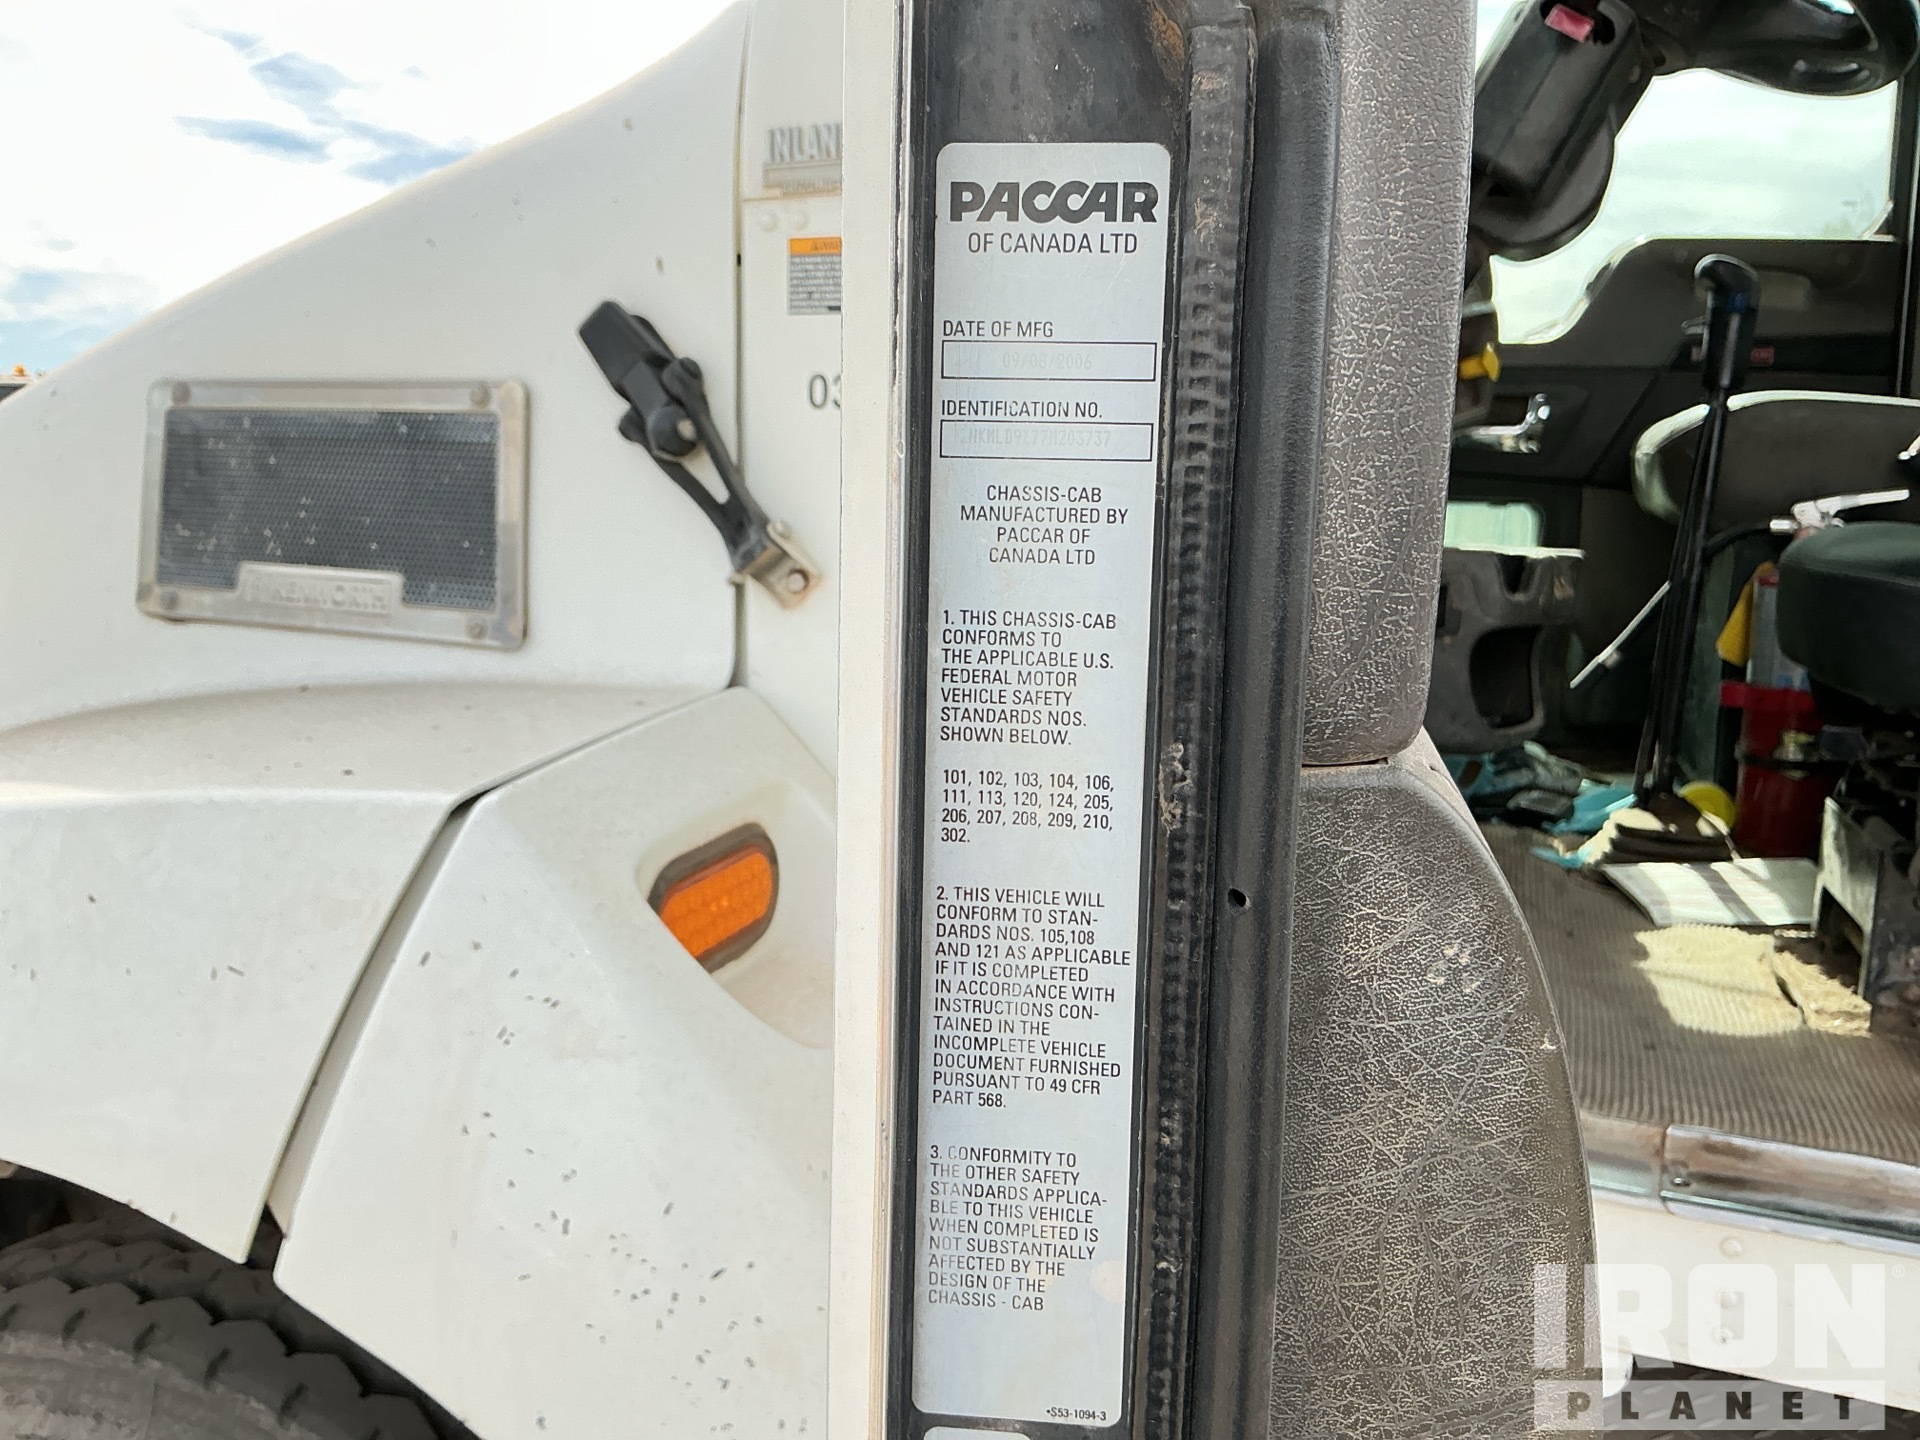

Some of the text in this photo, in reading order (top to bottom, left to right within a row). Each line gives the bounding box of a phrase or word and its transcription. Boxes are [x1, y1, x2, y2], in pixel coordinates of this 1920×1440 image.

[950, 180, 1159, 224] PACCAR
[969, 232, 1137, 253] OF CANADA LTD
[943, 320, 1053, 337] DATE OF MFG
[942, 400, 1102, 418] IDENTIFICATION NO.
[987, 485, 1101, 503] CHASSIS-CAB
[961, 505, 1128, 524] MANUFACTURED BY
[997, 526, 1090, 544] PACCAR OF
[990, 547, 1095, 565] CANADA LTD
[944, 610, 1116, 629] 1. THIS CHASSIS-CAB
[943, 629, 1061, 647] CONFORMS TO
[941, 648, 1113, 669] THE APPLICABLE U.S.
[942, 668, 1077, 687] FEDERAL MOTOR
[941, 687, 1072, 706] VEHICLE SAFETY
[940, 706, 1086, 726] STANDARDS NOS.
[940, 725, 1071, 745] SHOWN BELOW.
[944, 769, 1114, 792] 101, 102, 103, 104, 106,
[943, 789, 1113, 812] 111, 113, 120, 124, 205,
[942, 808, 1112, 831] 206, 207, 208, 209, 210,
[941, 827, 970, 843] 302.
[937, 886, 1105, 908] 2. THIS VEHICLE WILL
[937, 904, 1098, 926] CONFORM TO STAN-
[936, 923, 1094, 946] DARDS NOS. 105,108
[935, 941, 1131, 966] AND 121 AS APPLICABLE
[936, 960, 1088, 982] IF IT IS COMPLETED
[935, 979, 1114, 1003] IN ACCORDANCE WITH
[935, 997, 1099, 1020] INSTRUCTIONS CON-
[933, 1015, 1050, 1036] TAINED IN THE
[934, 1034, 1106, 1058] INCOMPLETE VEHICLE
[934, 1052, 1120, 1077] DOCUMENT FURNISHED
[933, 1071, 1100, 1095] PURSUANT TO 49 CFR
[933, 1089, 1006, 1108] PART 568.
[930, 1145, 1076, 1168] 3. CONFORMITY TO
[930, 1162, 1079, 1186] THE OTHER SAFETY
[930, 1181, 1107, 1206] STANDARDS APPLICA-
[930, 1199, 1093, 1224] BLE TO THIS VEHICLE
[929, 1217, 1098, 1242] WHEN COMPLETED IS
[930, 1235, 1095, 1260] NOT SUBSTANTIALLY
[929, 1254, 1065, 1276] AFFECTED BY THE
[929, 1271, 1045, 1293] DESIGN OF THE
[929, 1290, 995, 1307] CHASSIS
[1012, 1295, 1043, 1310] CAB
